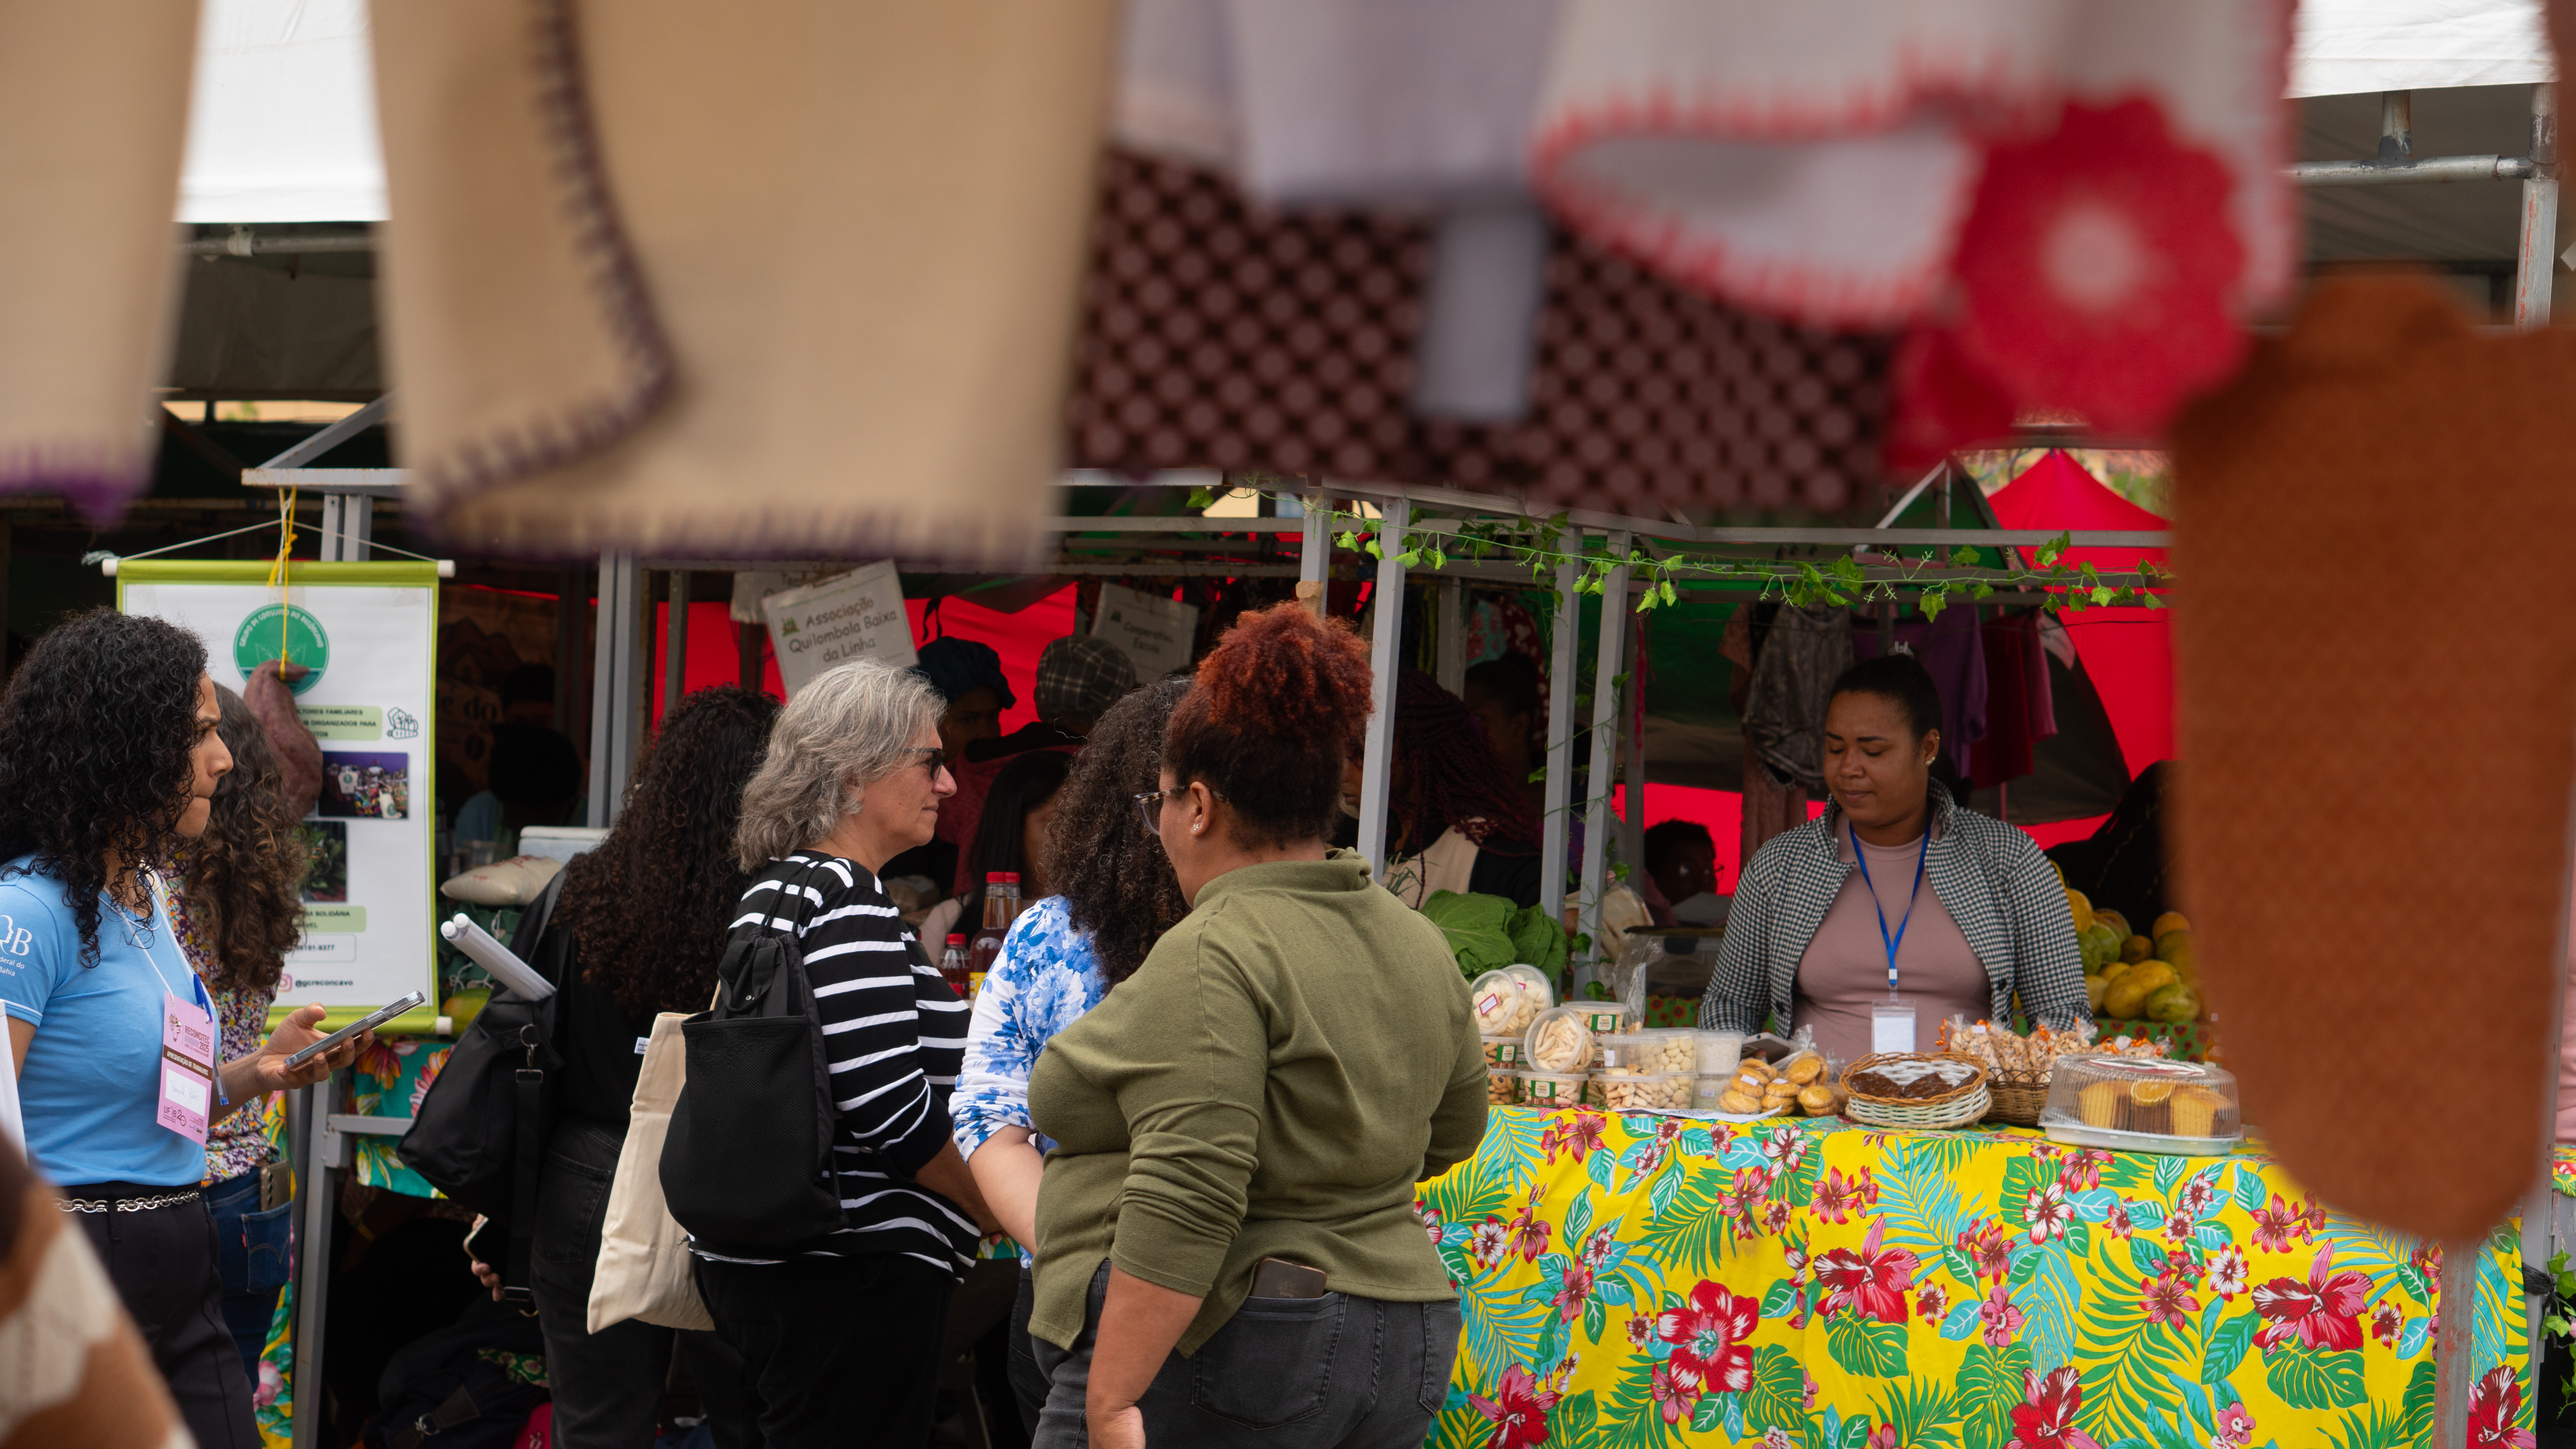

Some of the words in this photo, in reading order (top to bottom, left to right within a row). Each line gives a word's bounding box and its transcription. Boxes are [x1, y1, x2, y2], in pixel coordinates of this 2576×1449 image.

[291, 610, 301, 619] DO
[806, 596, 874, 628] Associação
[789, 621, 861, 654] Quilombola
[863, 609, 898, 630] Baixa
[823, 649, 839, 662] da
[841, 637, 876, 657] Linha
[185, 1025, 210, 1044] RECONCITEC
[199, 1042, 210, 1053] 2025
[167, 1051, 188, 1066] APRESENTAÇÃO
[192, 1063, 209, 1076] TRABALHOS
